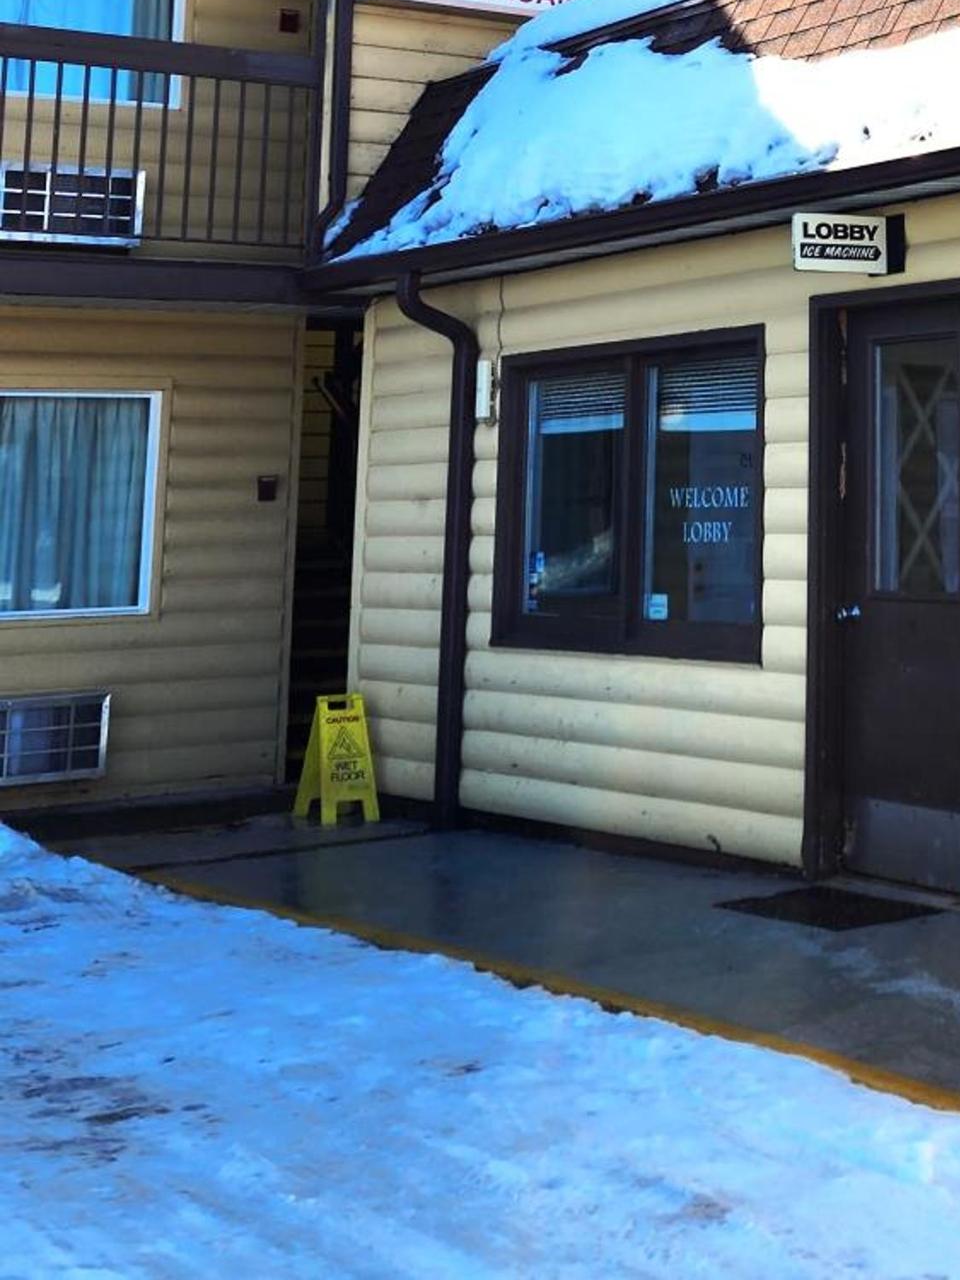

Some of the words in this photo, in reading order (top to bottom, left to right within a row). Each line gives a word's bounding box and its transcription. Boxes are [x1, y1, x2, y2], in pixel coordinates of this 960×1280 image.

[802, 221, 879, 241] LOBBY
[802, 246, 820, 257] ICE
[824, 247, 876, 259] MACHINE
[670, 486, 749, 508] WELCOME
[683, 521, 733, 543] LOBBY
